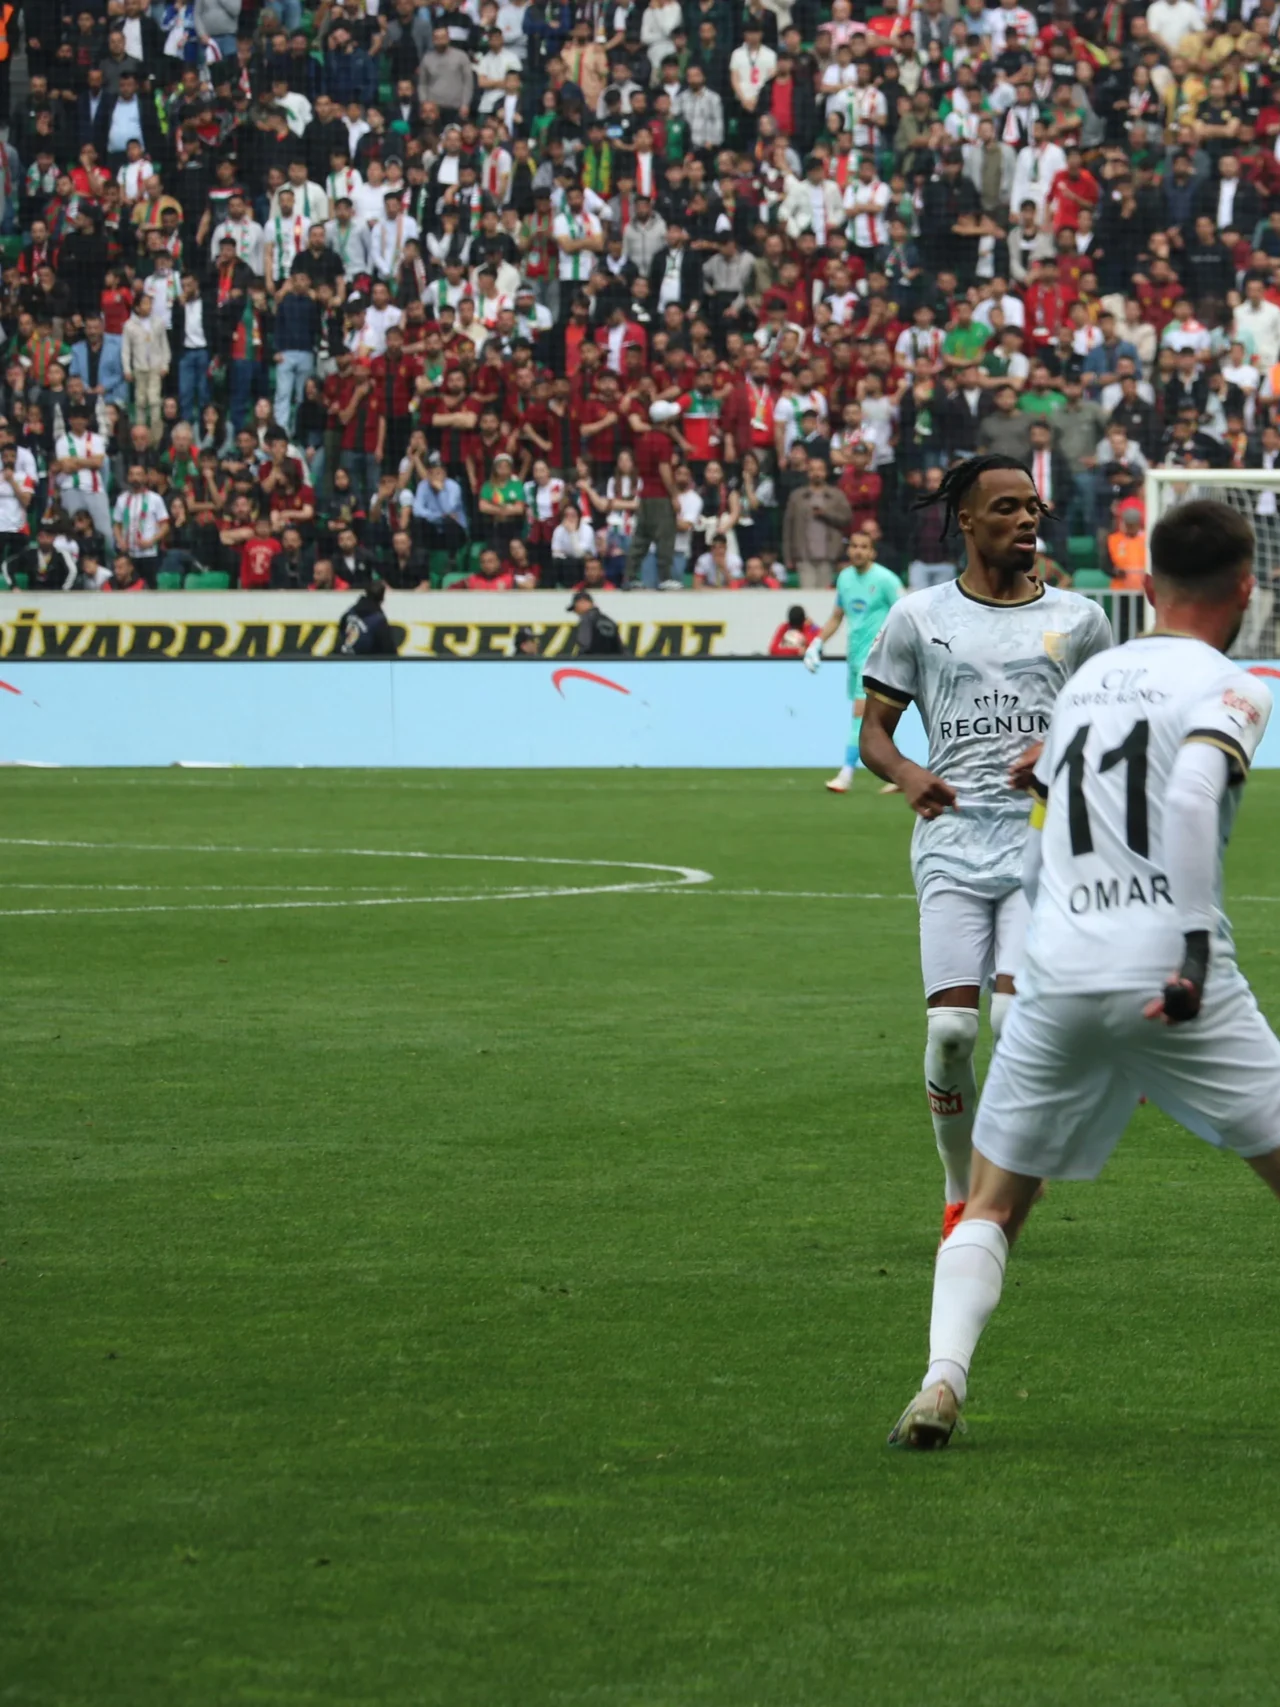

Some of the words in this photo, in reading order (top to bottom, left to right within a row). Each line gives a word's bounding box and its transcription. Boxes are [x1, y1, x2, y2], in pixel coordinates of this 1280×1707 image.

[1052, 719, 1149, 859] 11
[1069, 873, 1175, 915] OMAR
[930, 1097, 958, 1113] RM
